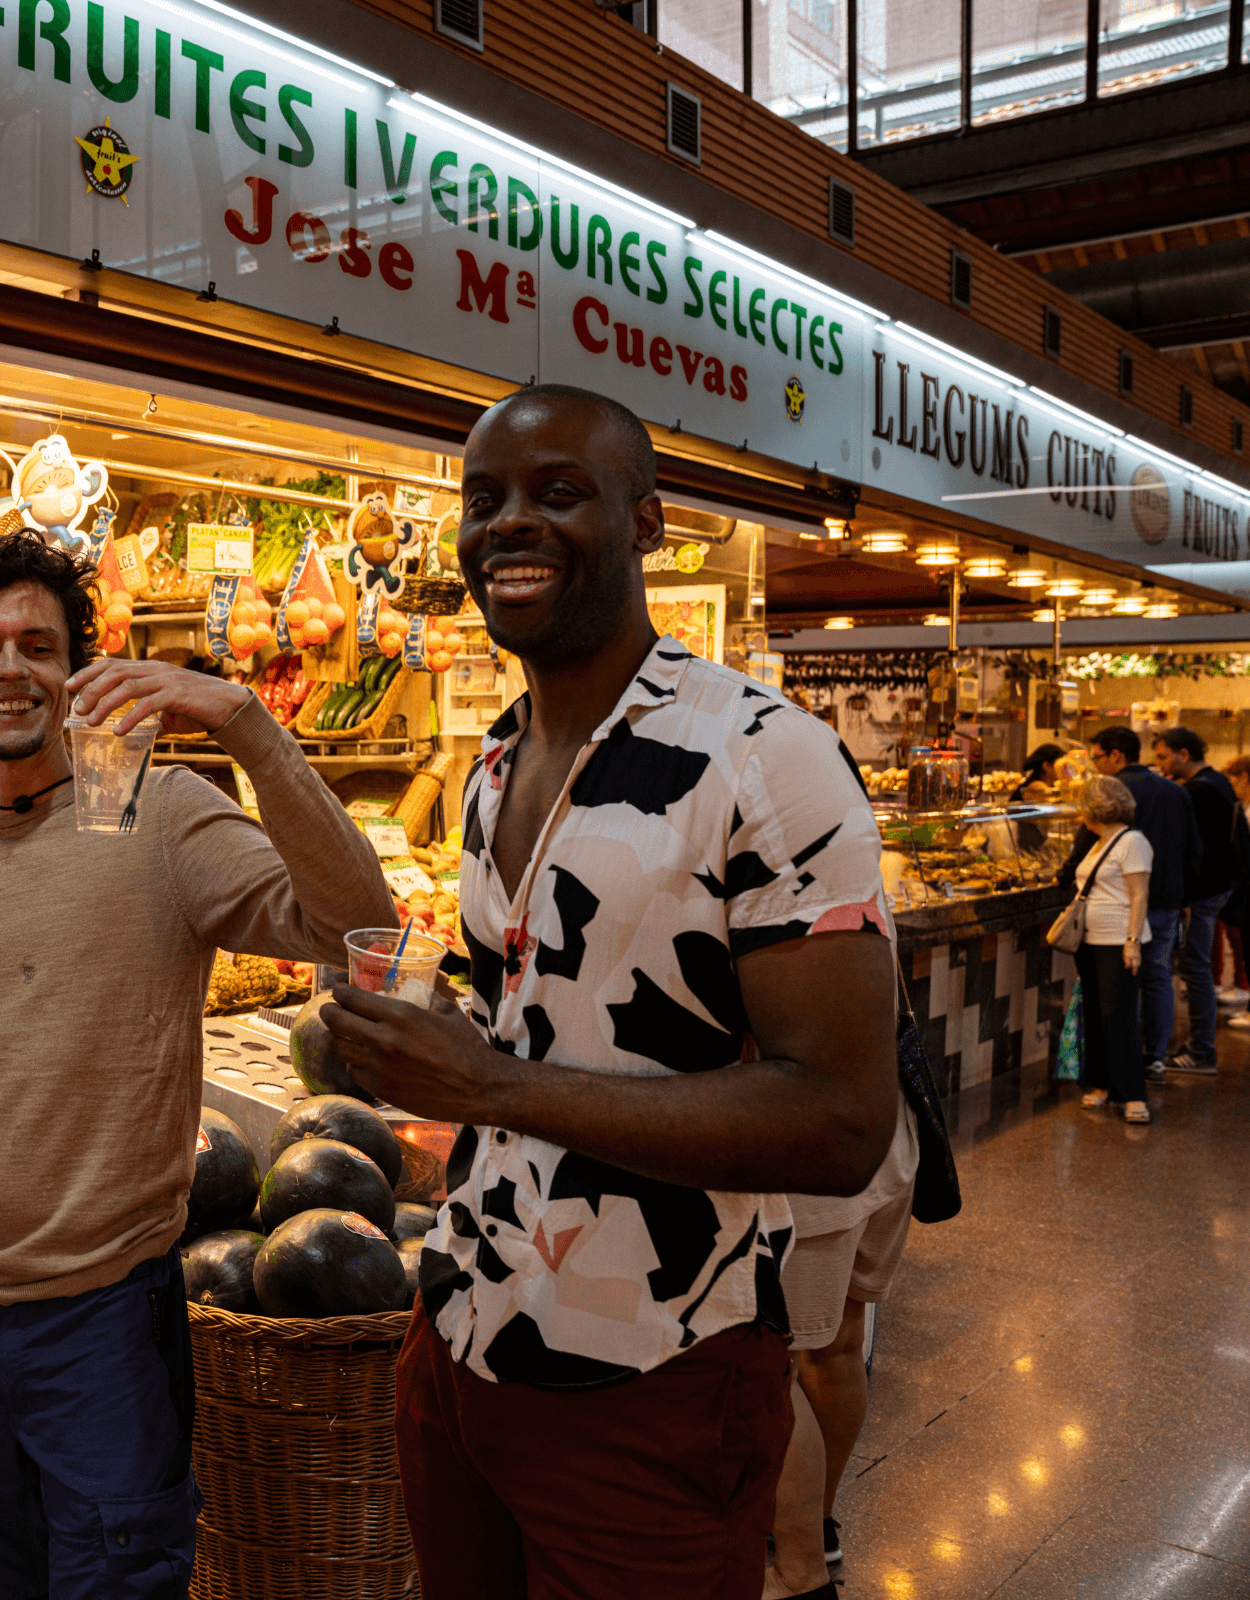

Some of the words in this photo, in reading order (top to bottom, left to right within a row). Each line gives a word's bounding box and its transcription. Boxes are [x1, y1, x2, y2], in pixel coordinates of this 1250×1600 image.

[224, 176, 414, 291] Jose
[572, 296, 748, 402] Cuevas
[376, 118, 668, 305] VERDURES
[684, 256, 844, 376] SELECTES
[872, 349, 1030, 490] LLEGUMS
[1048, 430, 1117, 522] CUITS
